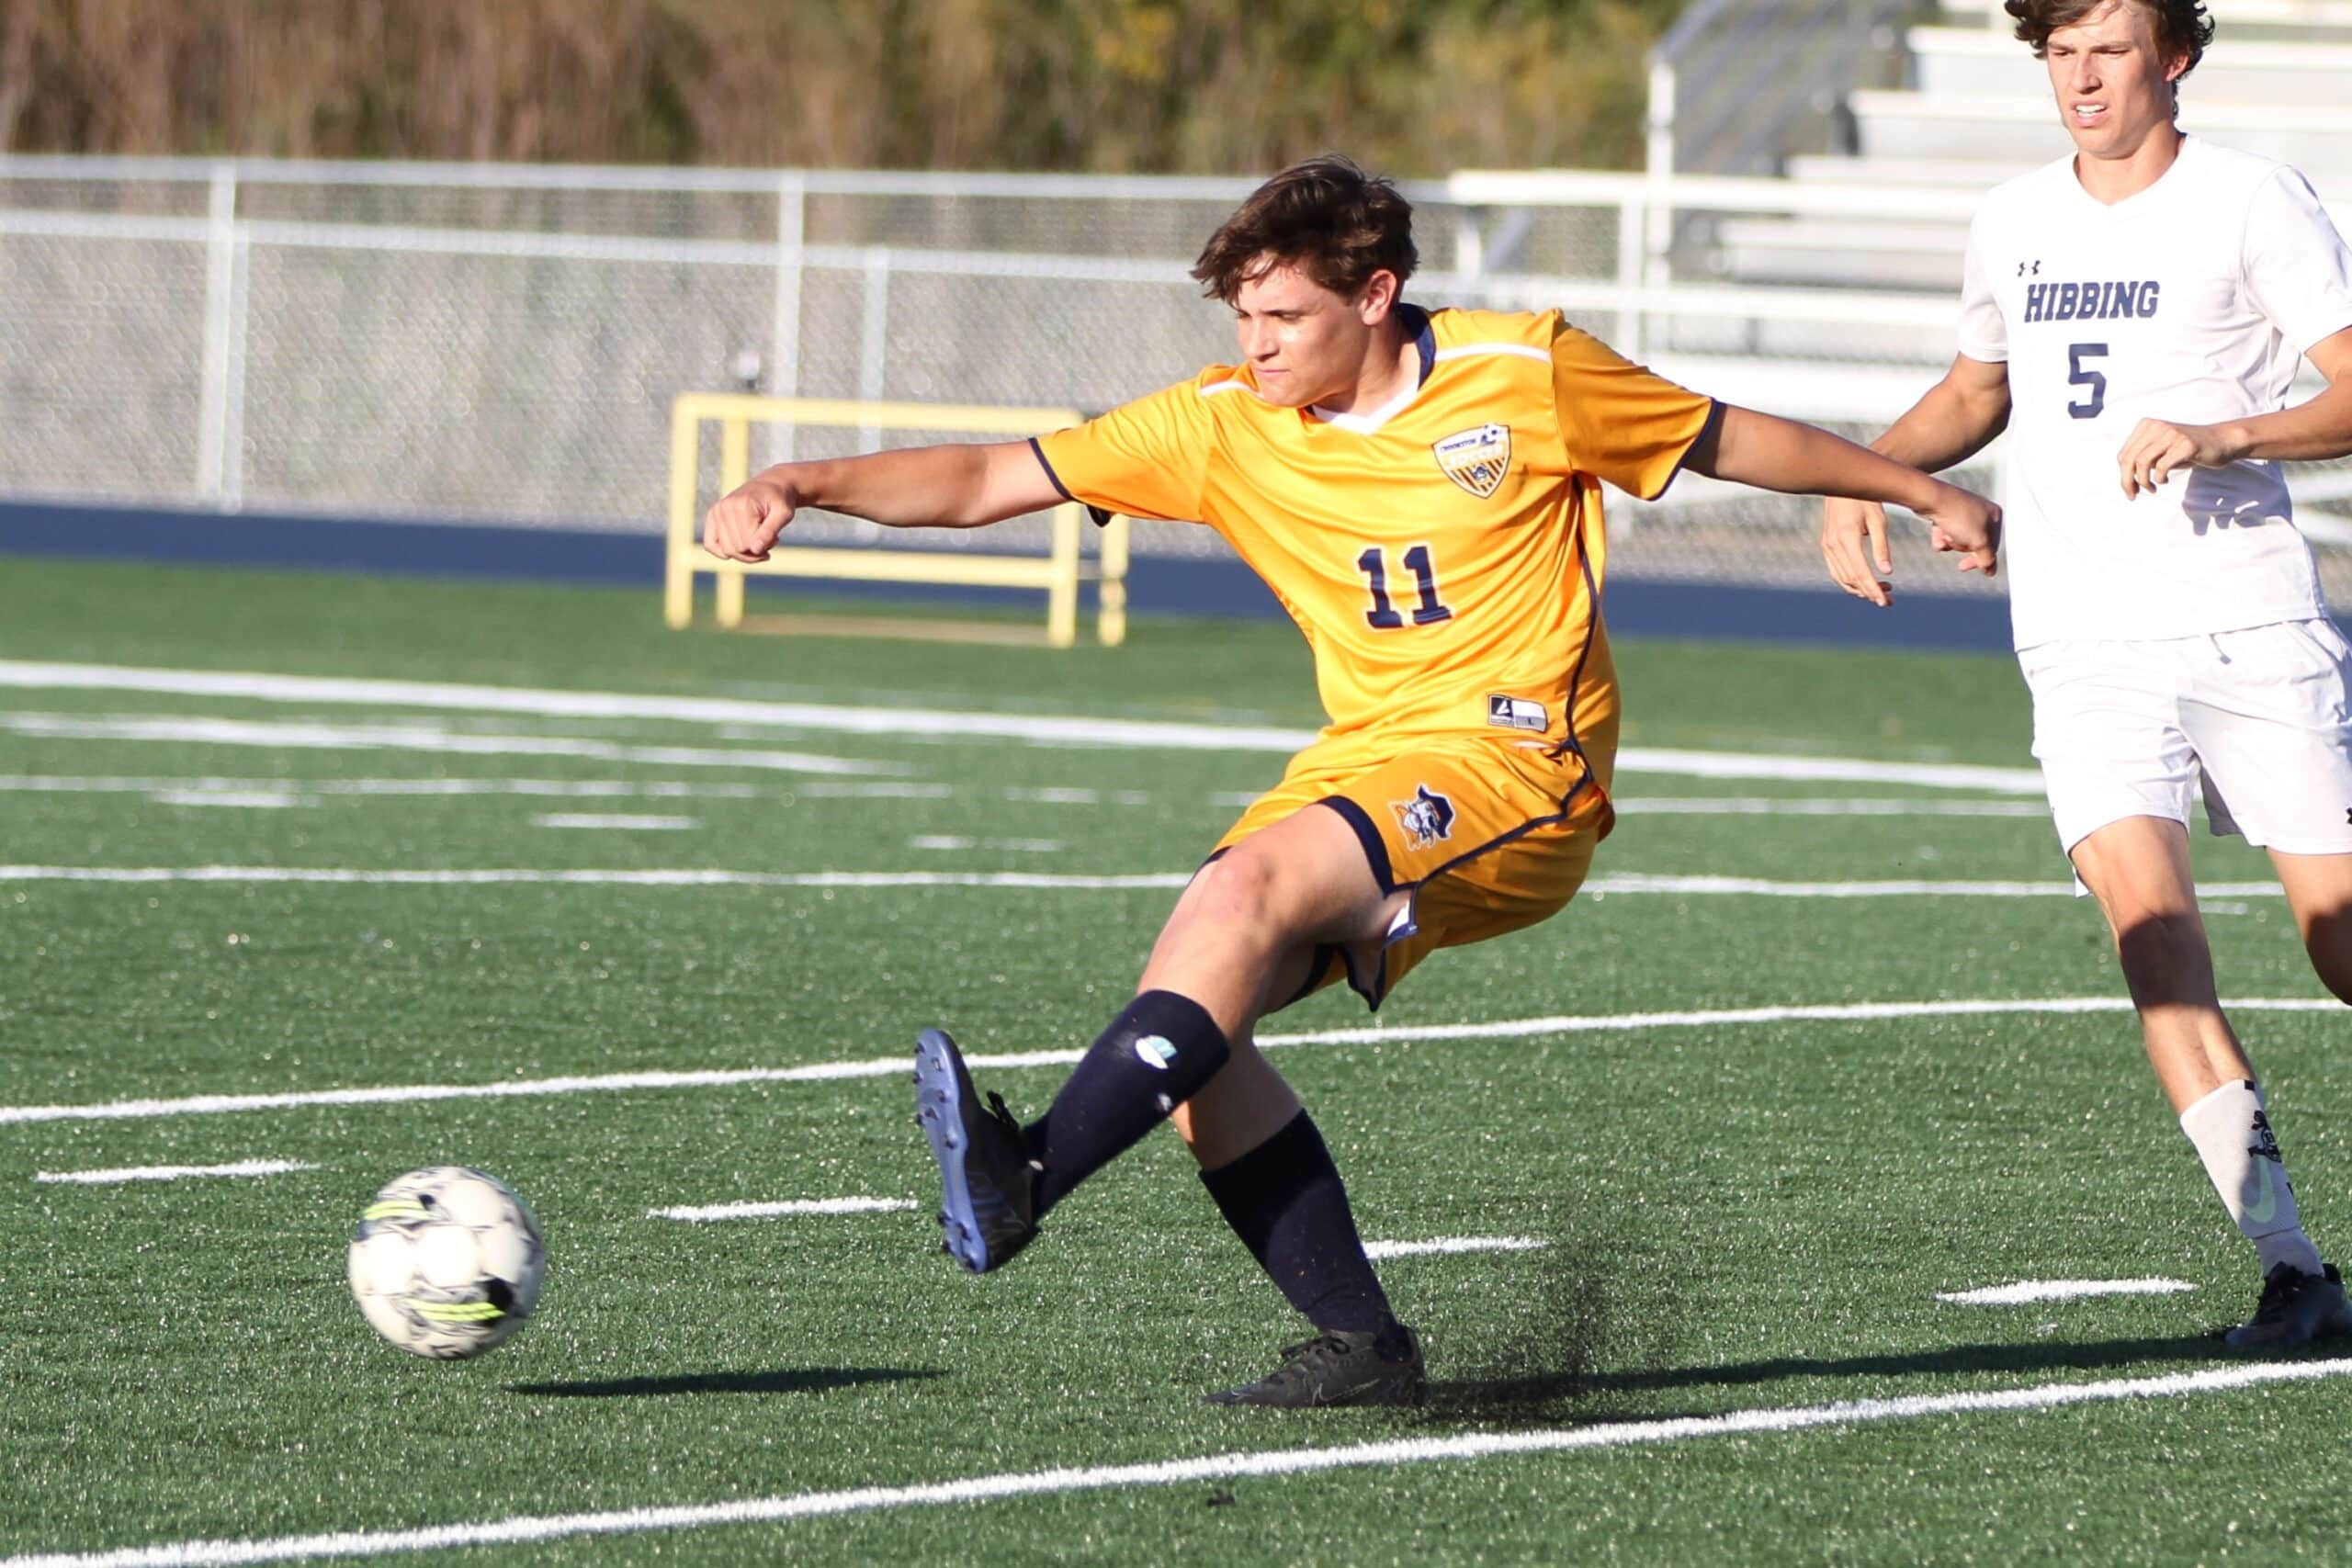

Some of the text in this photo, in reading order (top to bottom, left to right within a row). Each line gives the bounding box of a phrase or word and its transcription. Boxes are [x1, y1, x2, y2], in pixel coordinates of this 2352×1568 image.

[2024, 280, 2160, 322] HIBBING
[2067, 343, 2109, 419] 5
[1357, 546, 1453, 629] 11
